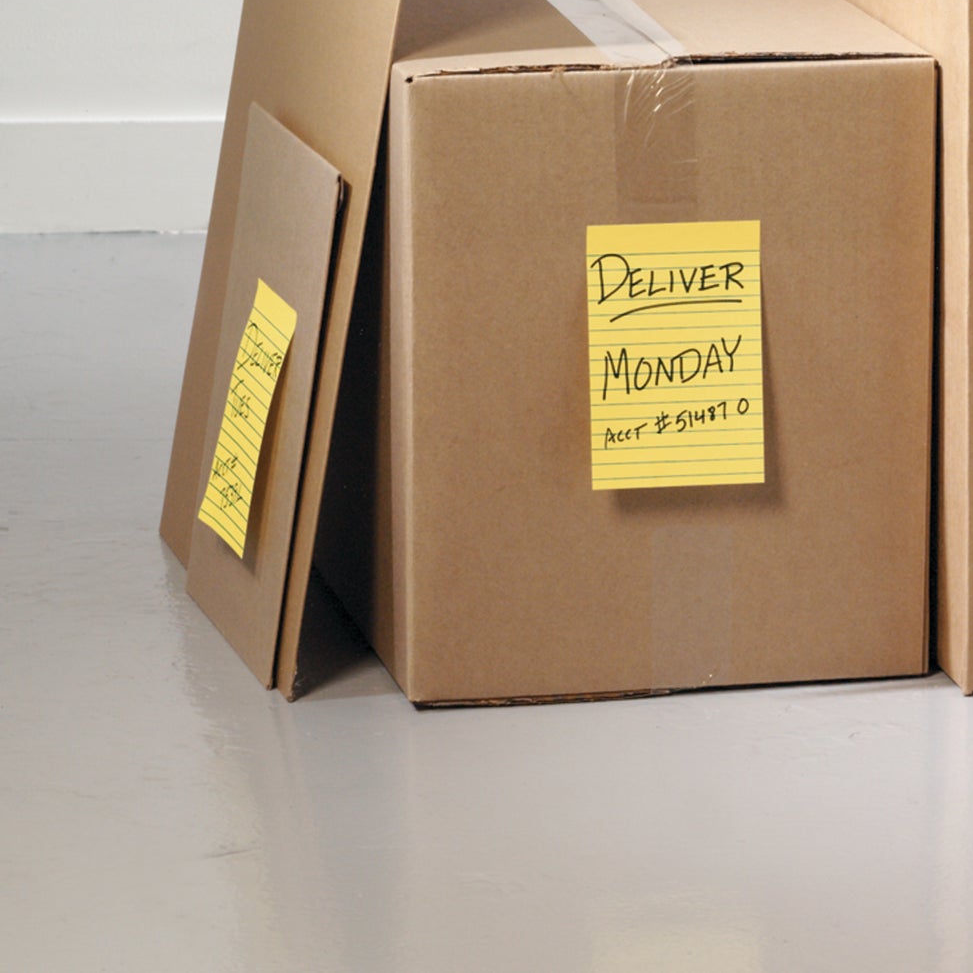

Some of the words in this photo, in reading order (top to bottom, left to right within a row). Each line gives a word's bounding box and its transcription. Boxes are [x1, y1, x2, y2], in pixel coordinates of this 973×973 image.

[590, 253, 745, 305] DELIVER
[602, 334, 743, 402] MONDAY
[604, 422, 648, 450] ACCT
